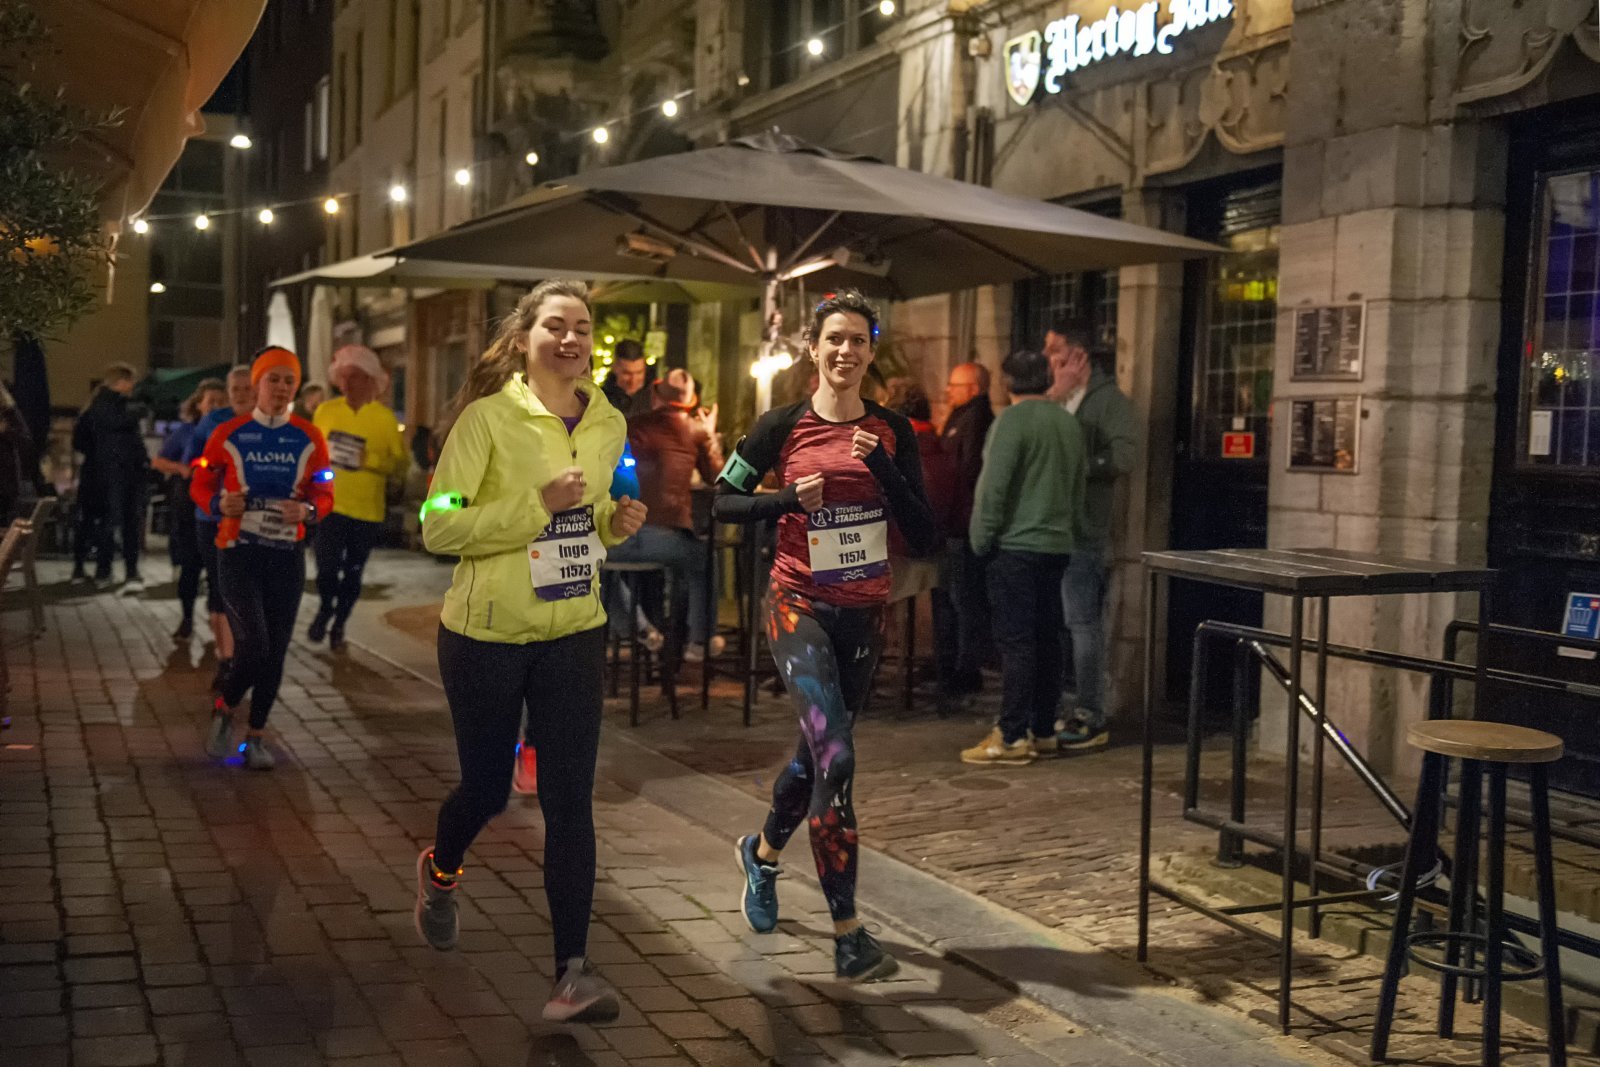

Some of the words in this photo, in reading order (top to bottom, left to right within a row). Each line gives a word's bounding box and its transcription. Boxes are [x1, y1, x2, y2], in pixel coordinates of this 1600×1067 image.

[245, 451, 296, 464] ALOHA
[834, 508, 884, 523] STADSCROSS
[835, 505, 863, 515] STEVENS
[555, 513, 587, 524] STEVENS
[839, 532, 862, 546] Ilse
[558, 543, 589, 559] Inge
[838, 549, 867, 565] 11574
[559, 563, 592, 579] 11573
